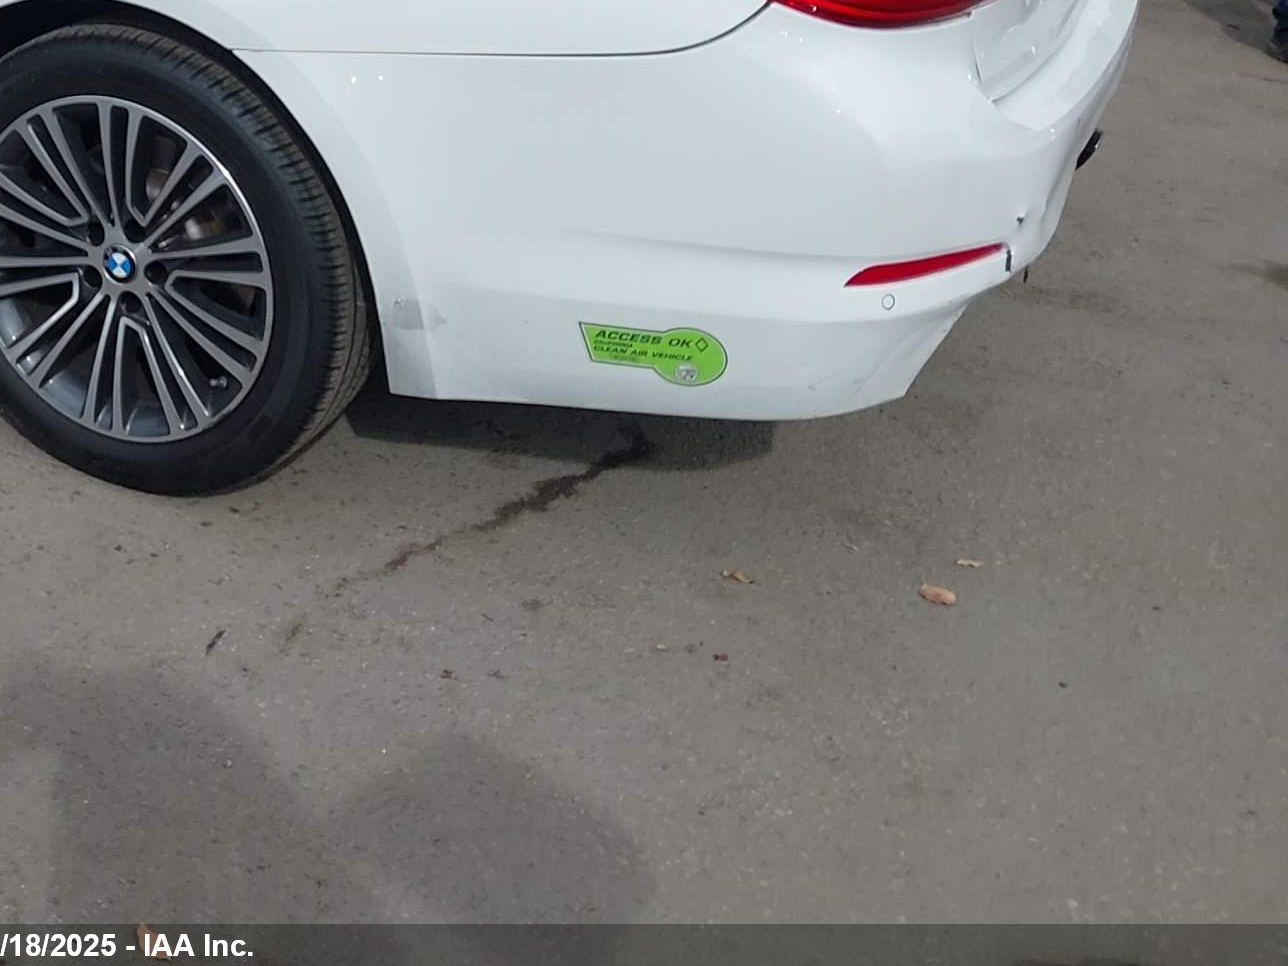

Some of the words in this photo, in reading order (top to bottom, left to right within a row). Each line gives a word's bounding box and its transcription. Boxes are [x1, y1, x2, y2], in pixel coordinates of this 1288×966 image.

[595, 329, 663, 345] ACCESS
[668, 338, 692, 348] OK
[593, 345, 628, 354] CLEAN
[630, 349, 649, 357] AIR
[652, 351, 693, 361] VEHICLE
